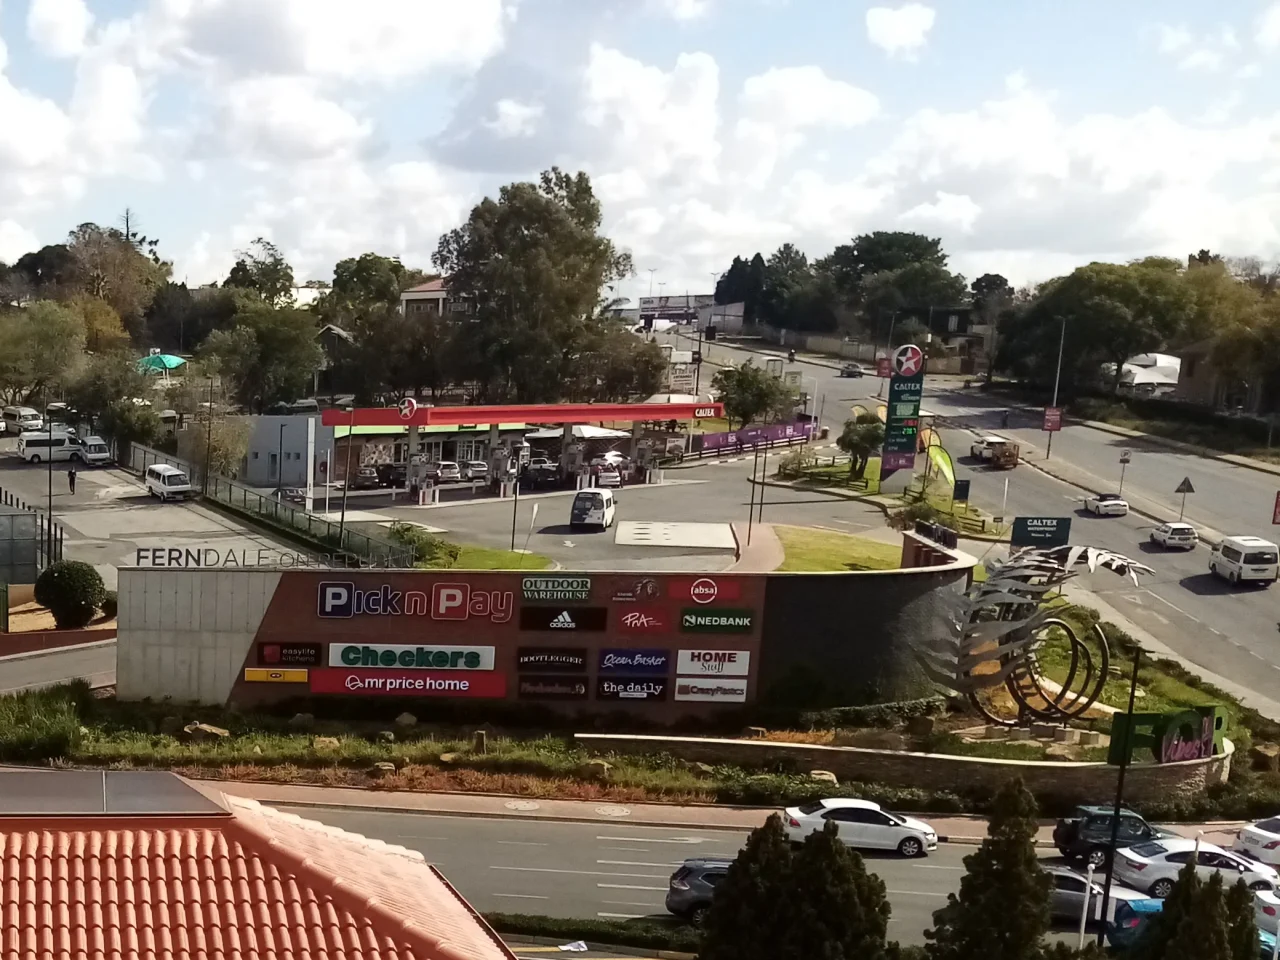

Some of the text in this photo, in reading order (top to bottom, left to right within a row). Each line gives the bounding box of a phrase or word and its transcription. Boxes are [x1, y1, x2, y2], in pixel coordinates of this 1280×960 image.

[695, 408, 715, 416] CALTEX
[136, 549, 270, 567] FERNDALE
[280, 552, 311, 568] ON
[523, 579, 589, 590] OUTDOOR
[693, 586, 715, 594] absa
[523, 591, 589, 599] WAREHOUSE
[318, 582, 513, 622] Pick n Pay
[549, 621, 576, 629] adidas
[696, 617, 751, 626] NEDBANK
[282, 648, 316, 656] easylife
[340, 645, 481, 669] Checkers
[690, 651, 737, 663] HOME
[520, 655, 583, 665] BOOTLEGGER
[601, 653, 633, 668] Ocean
[365, 676, 470, 691] mr price home
[603, 681, 663, 694] the daily
[690, 685, 745, 697] CrazyPlastics
